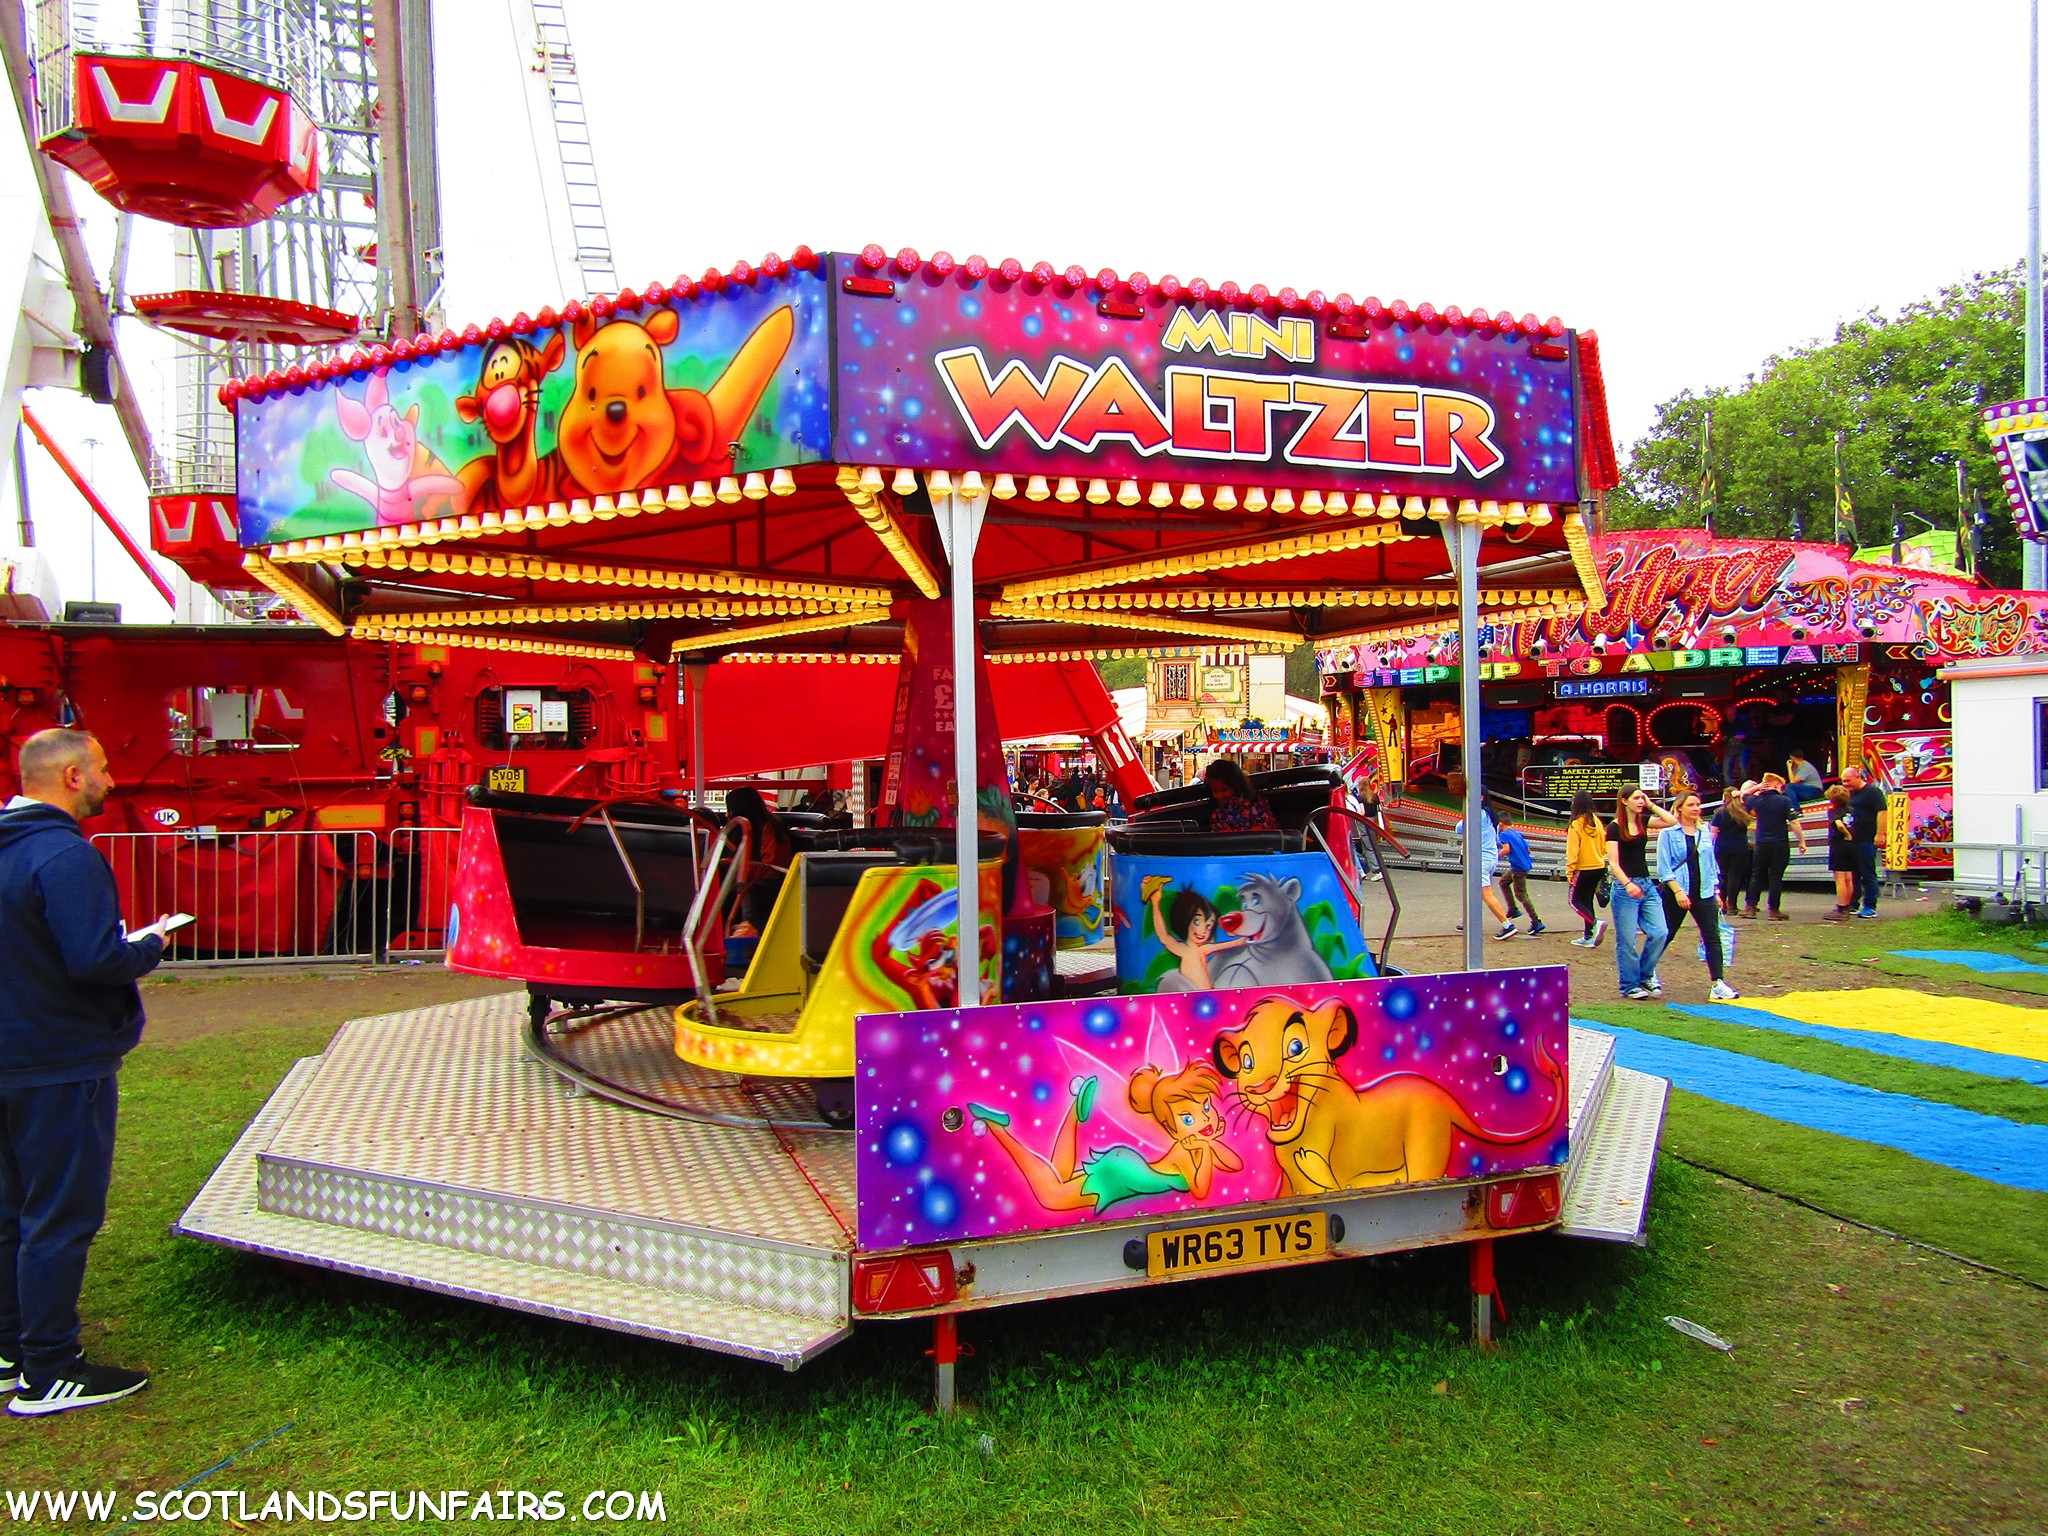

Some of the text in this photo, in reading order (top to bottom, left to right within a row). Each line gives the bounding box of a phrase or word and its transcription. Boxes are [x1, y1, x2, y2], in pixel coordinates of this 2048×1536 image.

[1163, 305, 1315, 363] MINI
[935, 346, 1505, 479] WALTZER
[1353, 665, 1449, 688] STEP
[1538, 657, 1602, 677] TO
[1620, 653, 1654, 673] A
[1672, 643, 1859, 669] DREAM
[1223, 728, 1282, 741] TOKENS
[157, 812, 176, 822] UK
[1895, 797, 1906, 867] HARRIS
[1162, 1220, 1312, 1269] WR63 TYS
